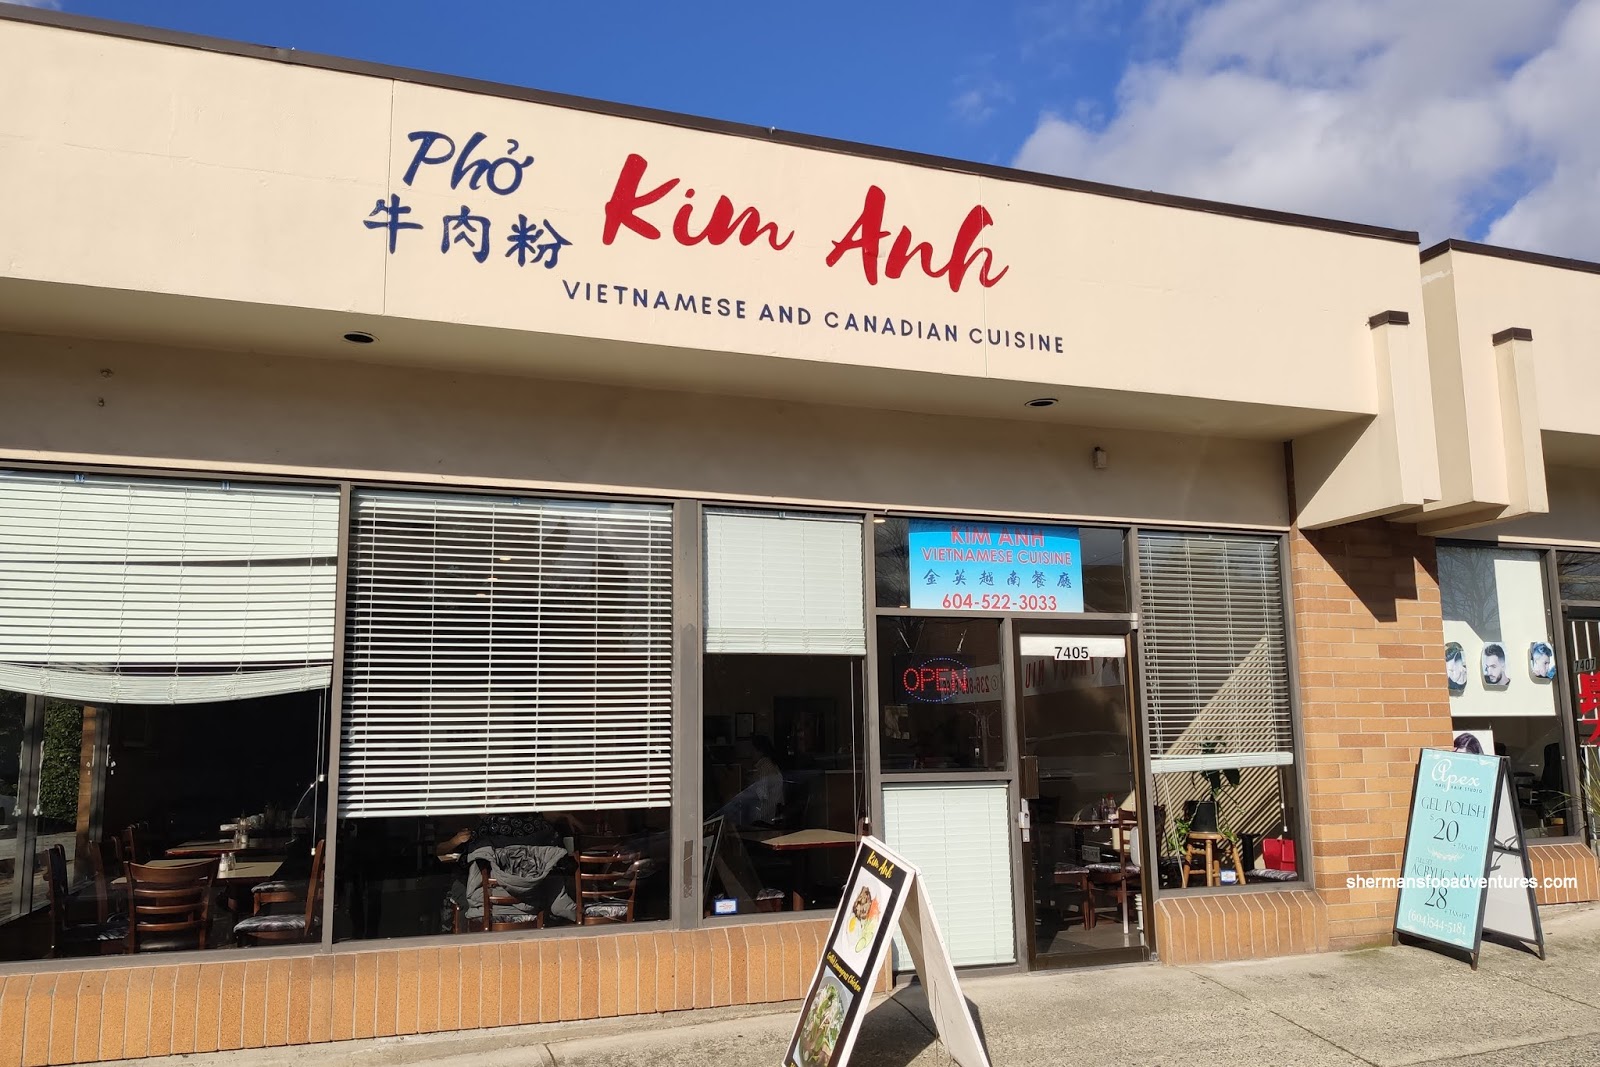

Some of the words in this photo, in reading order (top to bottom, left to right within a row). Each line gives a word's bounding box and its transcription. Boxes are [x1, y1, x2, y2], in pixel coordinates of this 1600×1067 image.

[363, 192, 572, 270] 牛肉粉
[602, 153, 794, 250] Kim
[826, 184, 1009, 293] Anh
[563, 281, 746, 319] VIETNAMESE
[760, 304, 811, 326] AND
[826, 312, 959, 341] CANADIAN
[969, 328, 1065, 354] CUISINE
[950, 526, 991, 545] KIM
[998, 528, 1045, 547] ANH
[922, 547, 1012, 563] VIETNAMESE
[1017, 550, 1072, 565] CUISINE
[943, 593, 1057, 611] 604-522-3033
[1054, 647, 1089, 659] 7405
[903, 667, 967, 692] OPEN
[1432, 758, 1480, 792] Apex
[1421, 796, 1441, 811] GEL
[1445, 800, 1486, 818] POLISH
